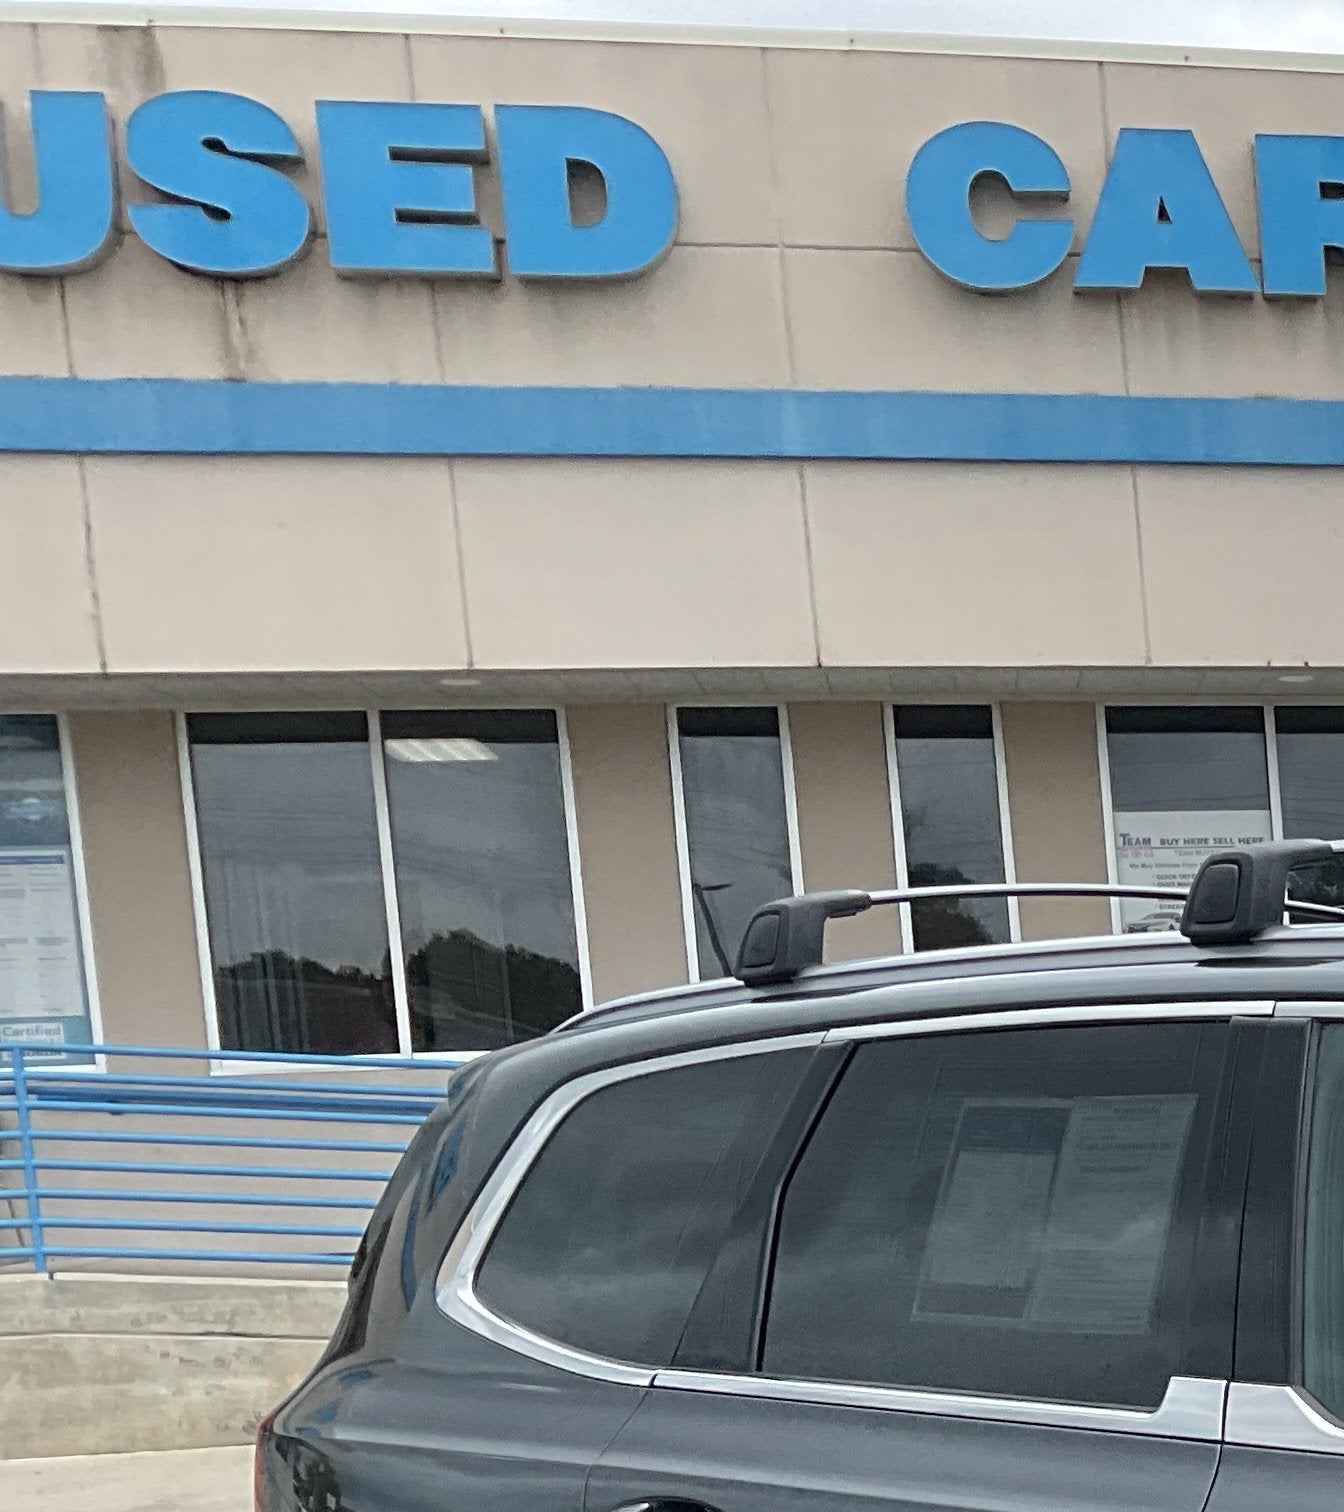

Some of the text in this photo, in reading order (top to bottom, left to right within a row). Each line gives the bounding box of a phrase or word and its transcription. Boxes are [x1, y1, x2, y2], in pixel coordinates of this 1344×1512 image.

[0, 88, 679, 281] USED
[1119, 832, 1265, 847] TEAM BUY HERE SELL HERE
[2, 1024, 61, 1037] Certified
